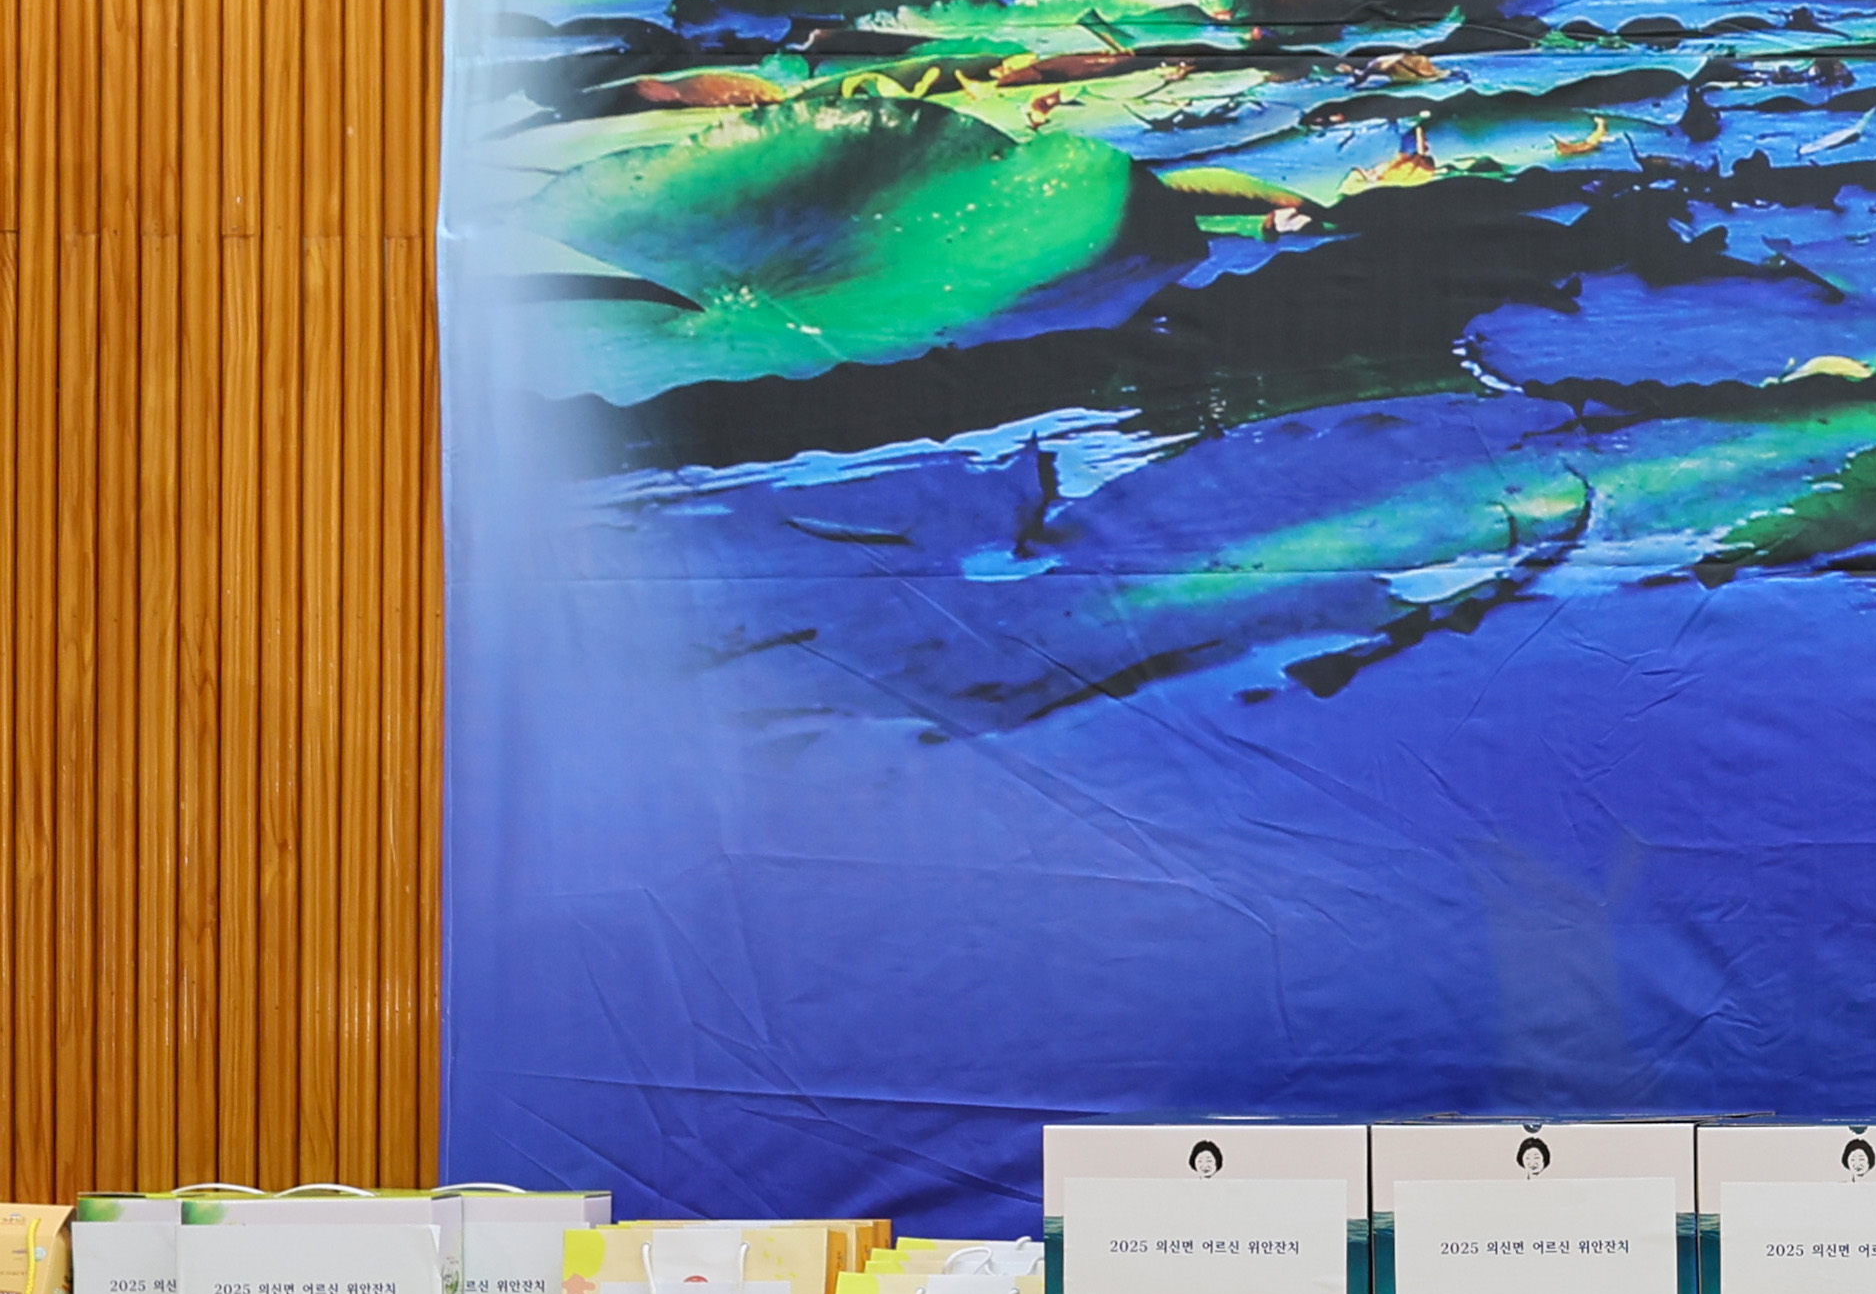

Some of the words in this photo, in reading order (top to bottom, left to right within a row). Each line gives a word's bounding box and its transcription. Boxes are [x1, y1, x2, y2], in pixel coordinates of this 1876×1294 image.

[1109, 1239, 1149, 1253] 2025
[1155, 1239, 1194, 1255] 의신면
[1201, 1239, 1240, 1255] 어르신
[1247, 1239, 1300, 1256] 위안잔치
[1440, 1241, 1480, 1255] 2025
[1486, 1240, 1525, 1256] 의신면
[1532, 1239, 1570, 1255] 어르신
[1577, 1239, 1629, 1255] 위안잔치
[1765, 1243, 1805, 1257] 2025
[1811, 1243, 1850, 1259] 의신면
[109, 1279, 147, 1293] 2025
[153, 1278, 178, 1294] 의신
[464, 1279, 490, 1294] 르신
[496, 1279, 546, 1294] 위안잔치
